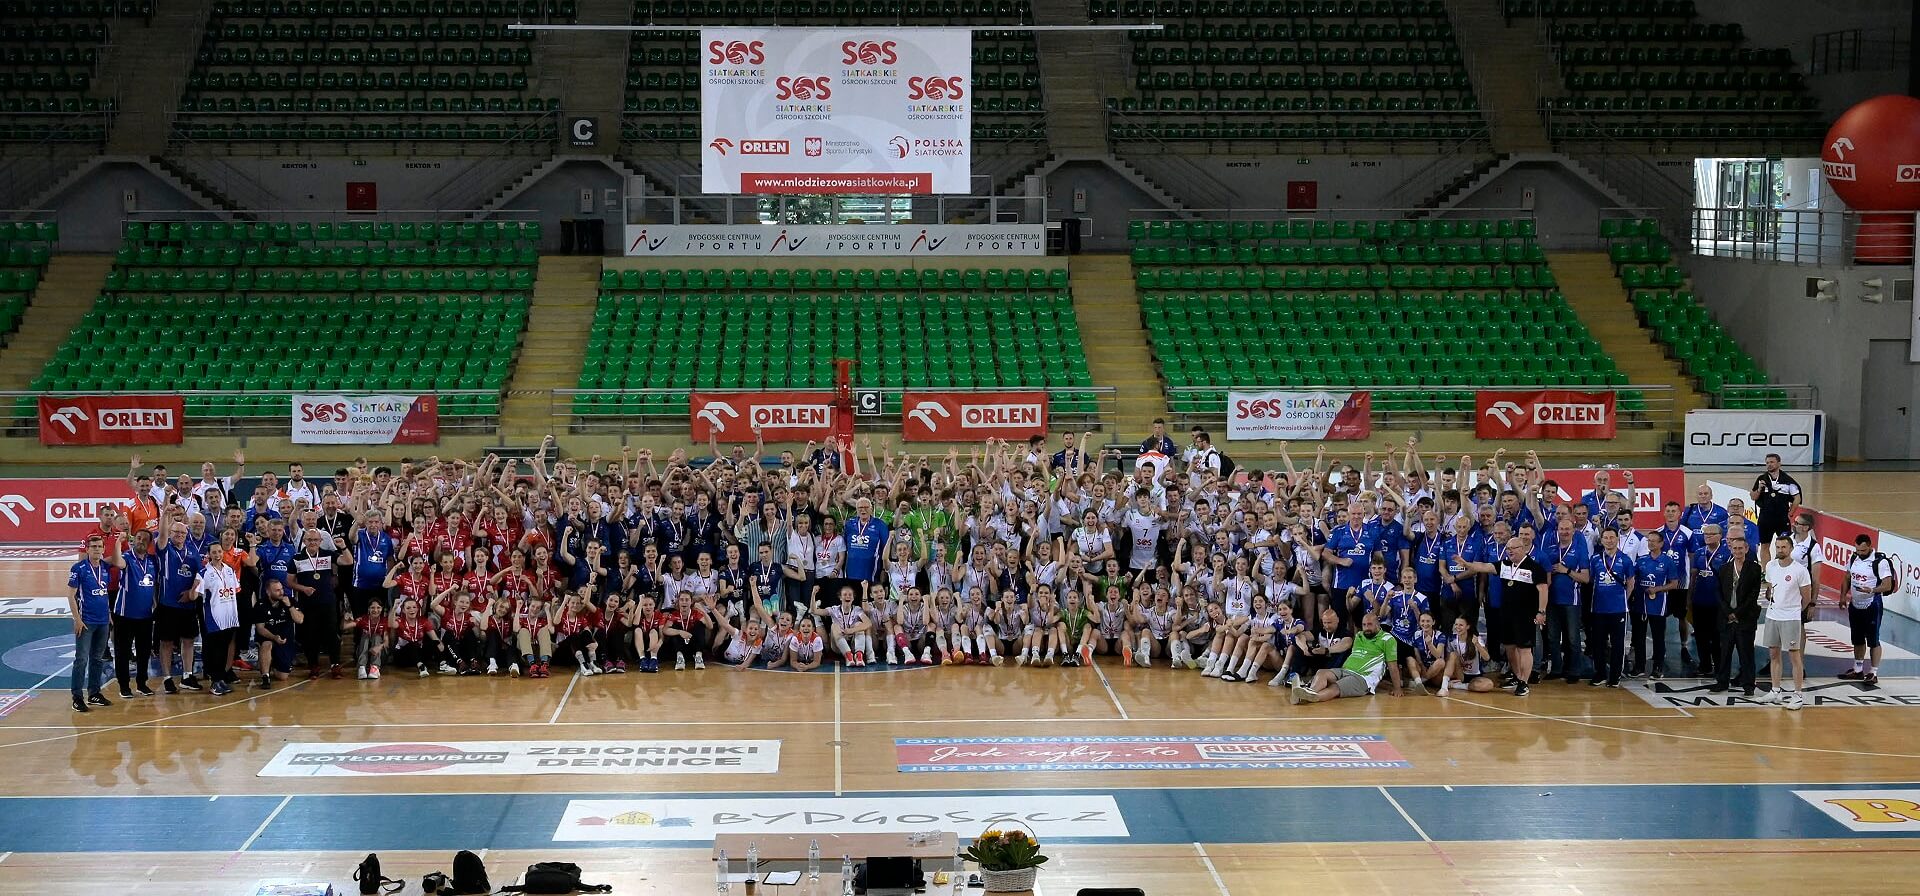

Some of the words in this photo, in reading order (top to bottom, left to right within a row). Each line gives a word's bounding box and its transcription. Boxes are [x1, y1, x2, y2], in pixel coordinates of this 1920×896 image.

[709, 41, 765, 65] SOS
[842, 41, 897, 65] SOS
[709, 69, 765, 77] SIATKARSKIE
[842, 69, 897, 77] SIATKARSKIE
[776, 76, 831, 100] SOS
[908, 76, 963, 100] SOS
[776, 104, 831, 112] SIATKARSKIE
[908, 104, 963, 112] SIATKARSKIE
[573, 119, 593, 140] C
[743, 142, 786, 153] ORLEN
[915, 139, 963, 147] POLSKA
[915, 148, 963, 156] SIATKÓWKA
[1823, 163, 1853, 178] RLEN
[755, 177, 918, 189] www.mlodziezowasiatkowka.pl
[861, 393, 877, 410] C
[1286, 399, 1362, 409] SIATKARSKIE
[301, 402, 347, 423] SOS
[351, 403, 429, 413] SIATKARSKIE
[1236, 398, 1282, 420] SOS
[755, 408, 825, 424] ORLEN
[966, 408, 1036, 424] ORLEN
[1286, 410, 1325, 419] OŚRODKI
[1538, 406, 1599, 421] ORLEN
[103, 412, 168, 427] ORLEN
[351, 414, 390, 424] OŚRODKI
[301, 428, 393, 437] www.mlodziezowasiatkowka.pl
[1236, 423, 1326, 432] www.mlodziezowasiatkowka.pl
[1691, 432, 1810, 447] asseco
[1142, 528, 1148, 537] 7
[1136, 538, 1152, 546] SOS
[1852, 572, 1868, 582] SOS
[1030, 735, 1225, 743] NAJSMACZNIEJSZE
[527, 746, 759, 755] ZBIORNIKI
[928, 746, 1009, 762] Jak
[1134, 746, 1179, 756] to
[1203, 744, 1353, 754] ABRAMCZYK
[294, 752, 503, 763] KOTŁOREMBUD
[537, 757, 742, 766] DENNICE
[1025, 762, 1193, 770] PRZYNAJMNIEJ
[712, 810, 1108, 825] BYDGOSZCZ
